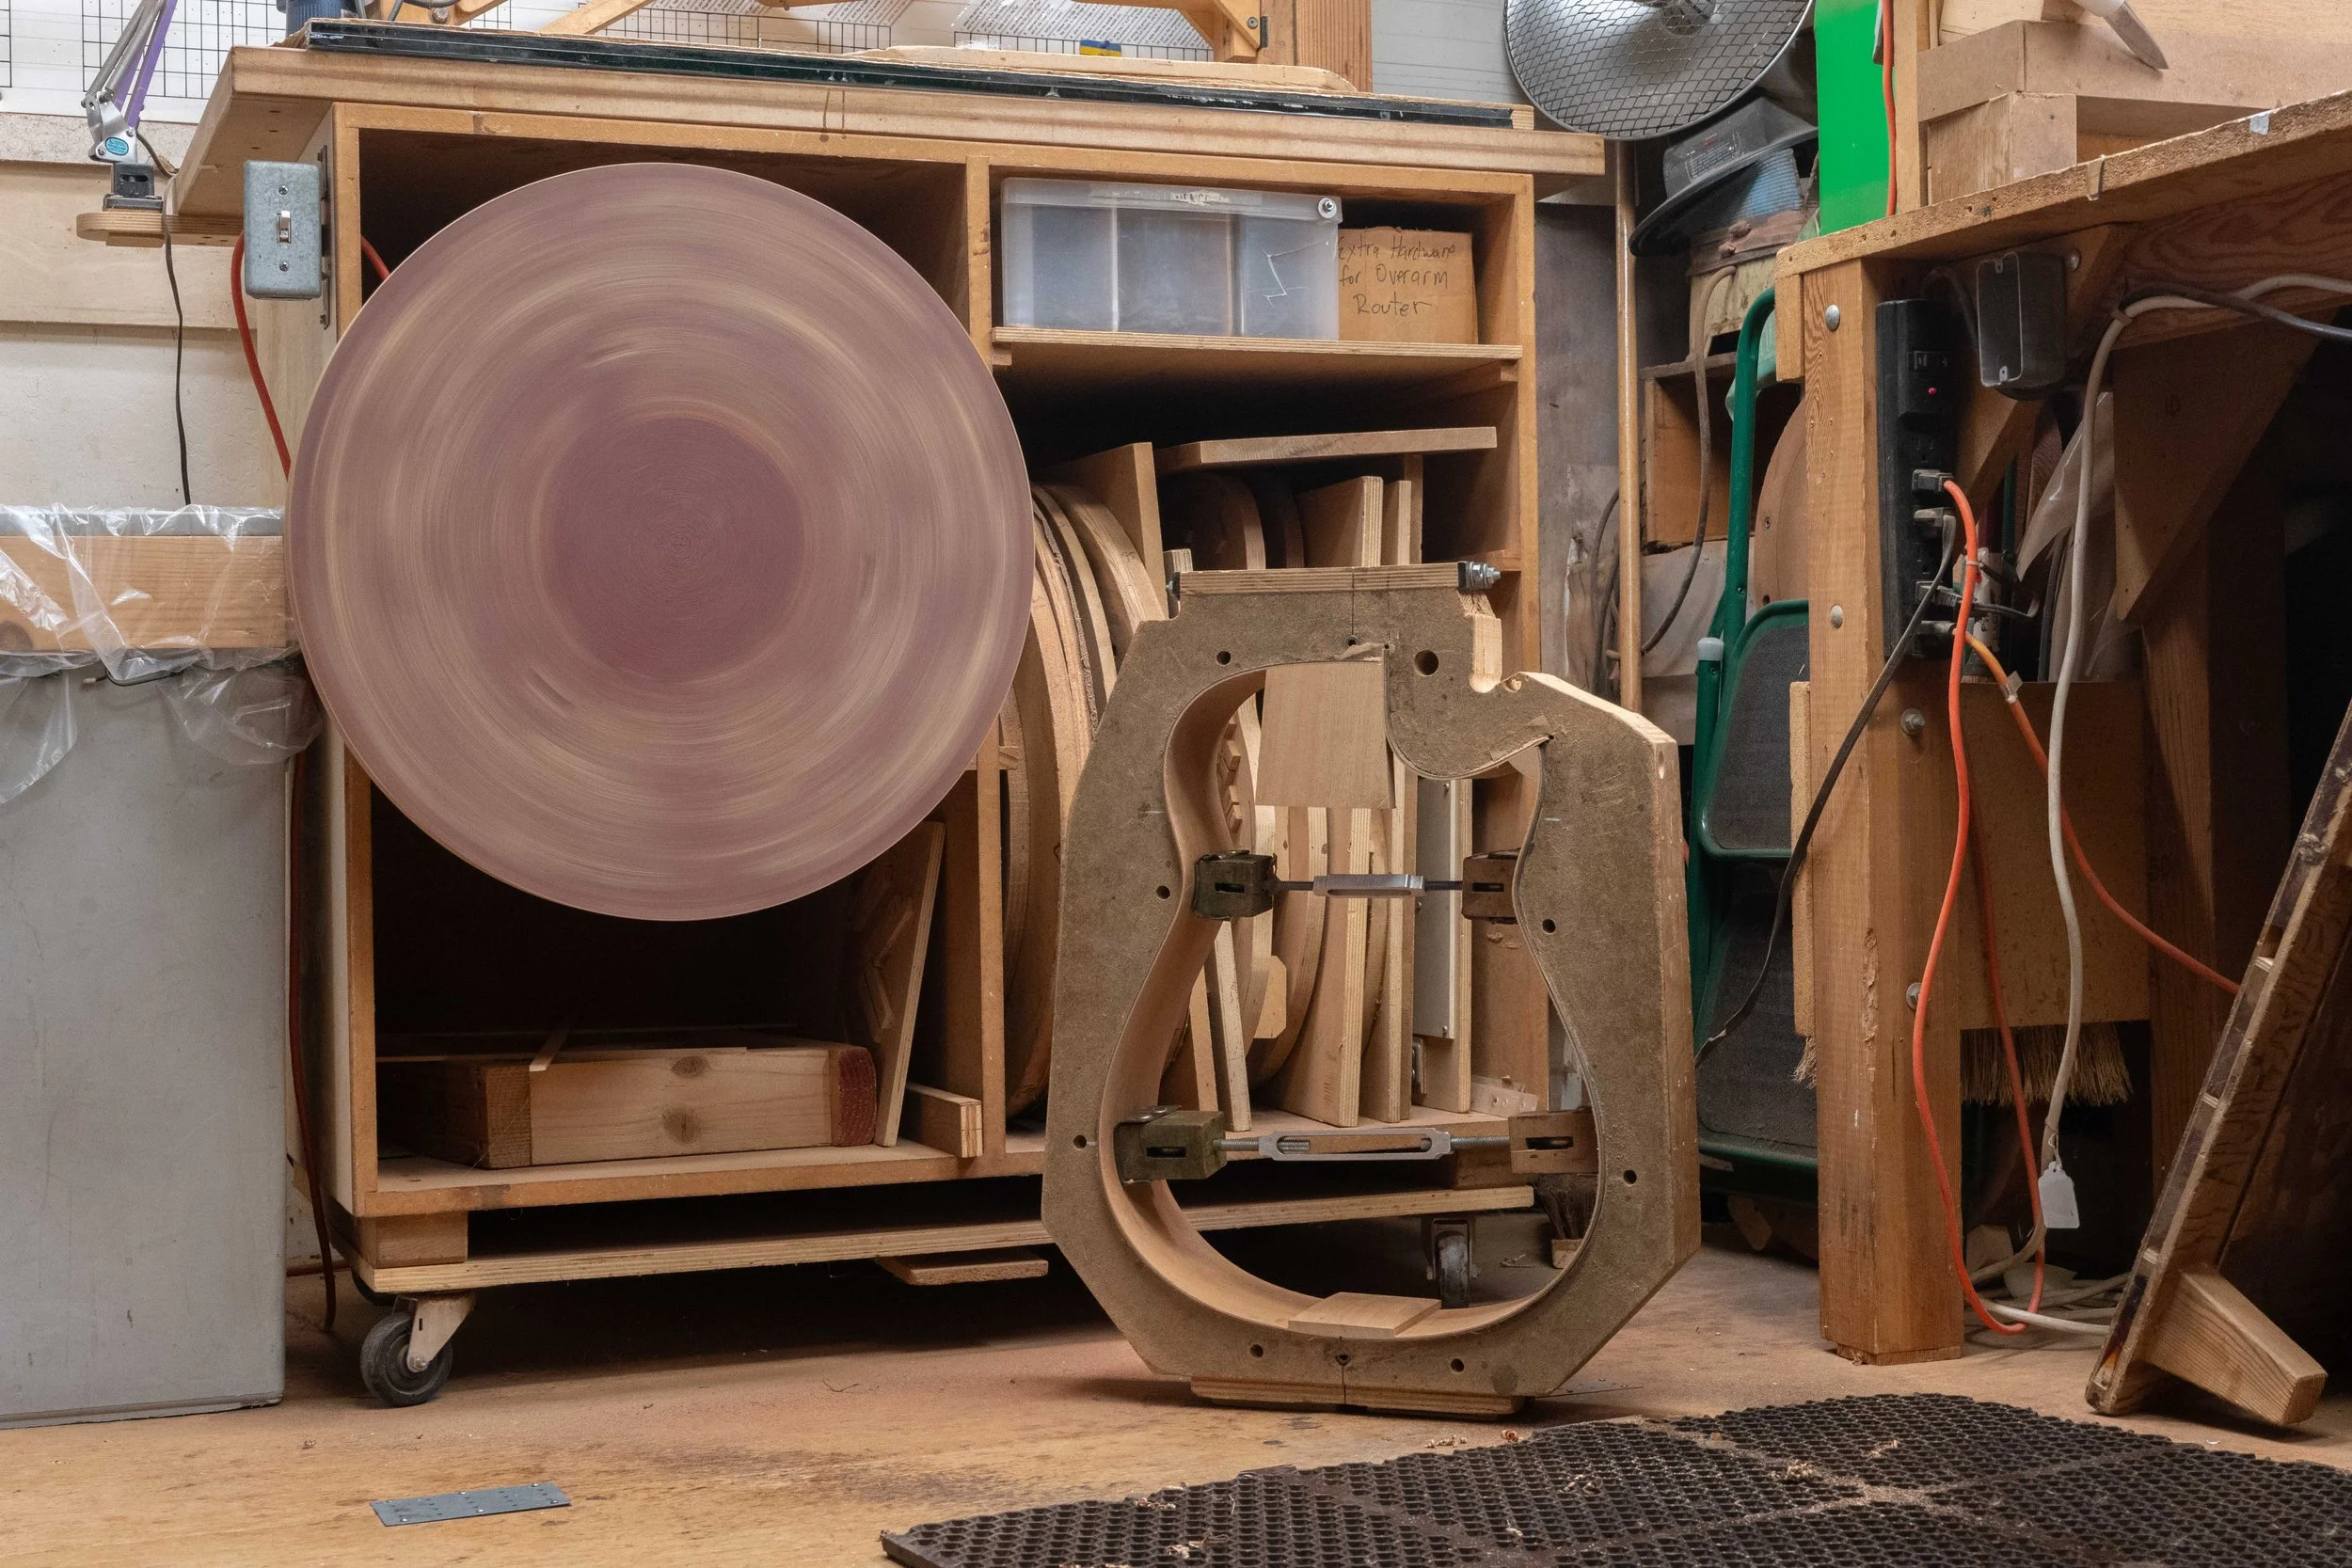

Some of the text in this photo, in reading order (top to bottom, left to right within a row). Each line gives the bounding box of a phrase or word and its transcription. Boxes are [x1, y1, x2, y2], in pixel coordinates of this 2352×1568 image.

[1338, 233, 1456, 263] Extra Hardware
[1339, 263, 1448, 289] for Overarm
[1353, 292, 1432, 317] Router
